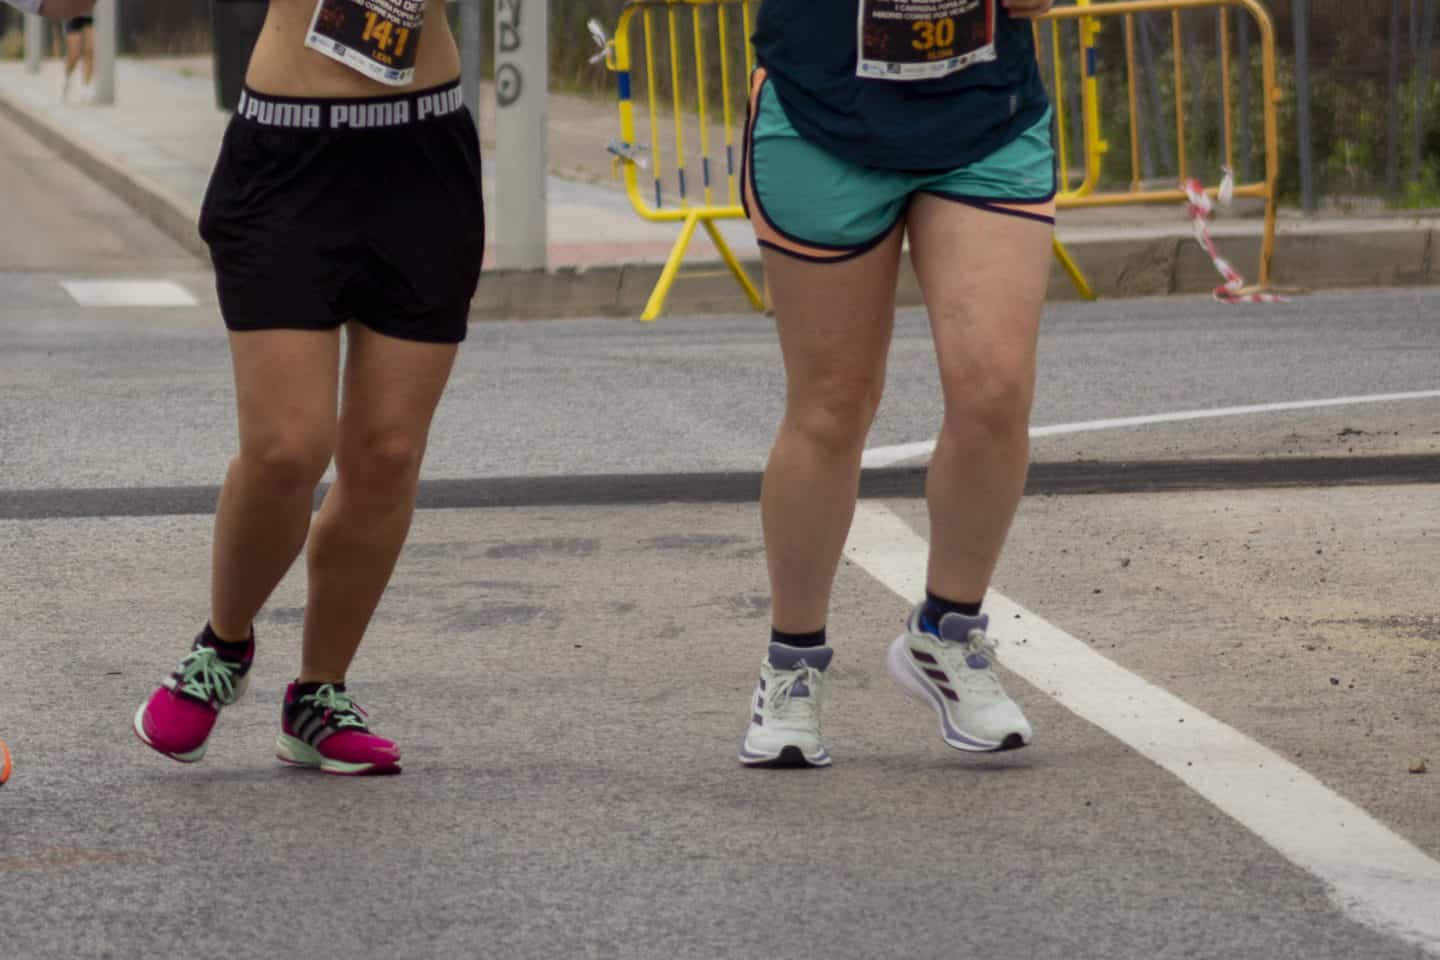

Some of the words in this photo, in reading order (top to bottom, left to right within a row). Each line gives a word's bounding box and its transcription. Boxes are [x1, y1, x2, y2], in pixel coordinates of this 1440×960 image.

[403, 1, 418, 13] DE
[361, 10, 409, 57] 141
[912, 18, 955, 50] 30
[246, 96, 320, 128] PUMA
[330, 100, 409, 128] PUMA
